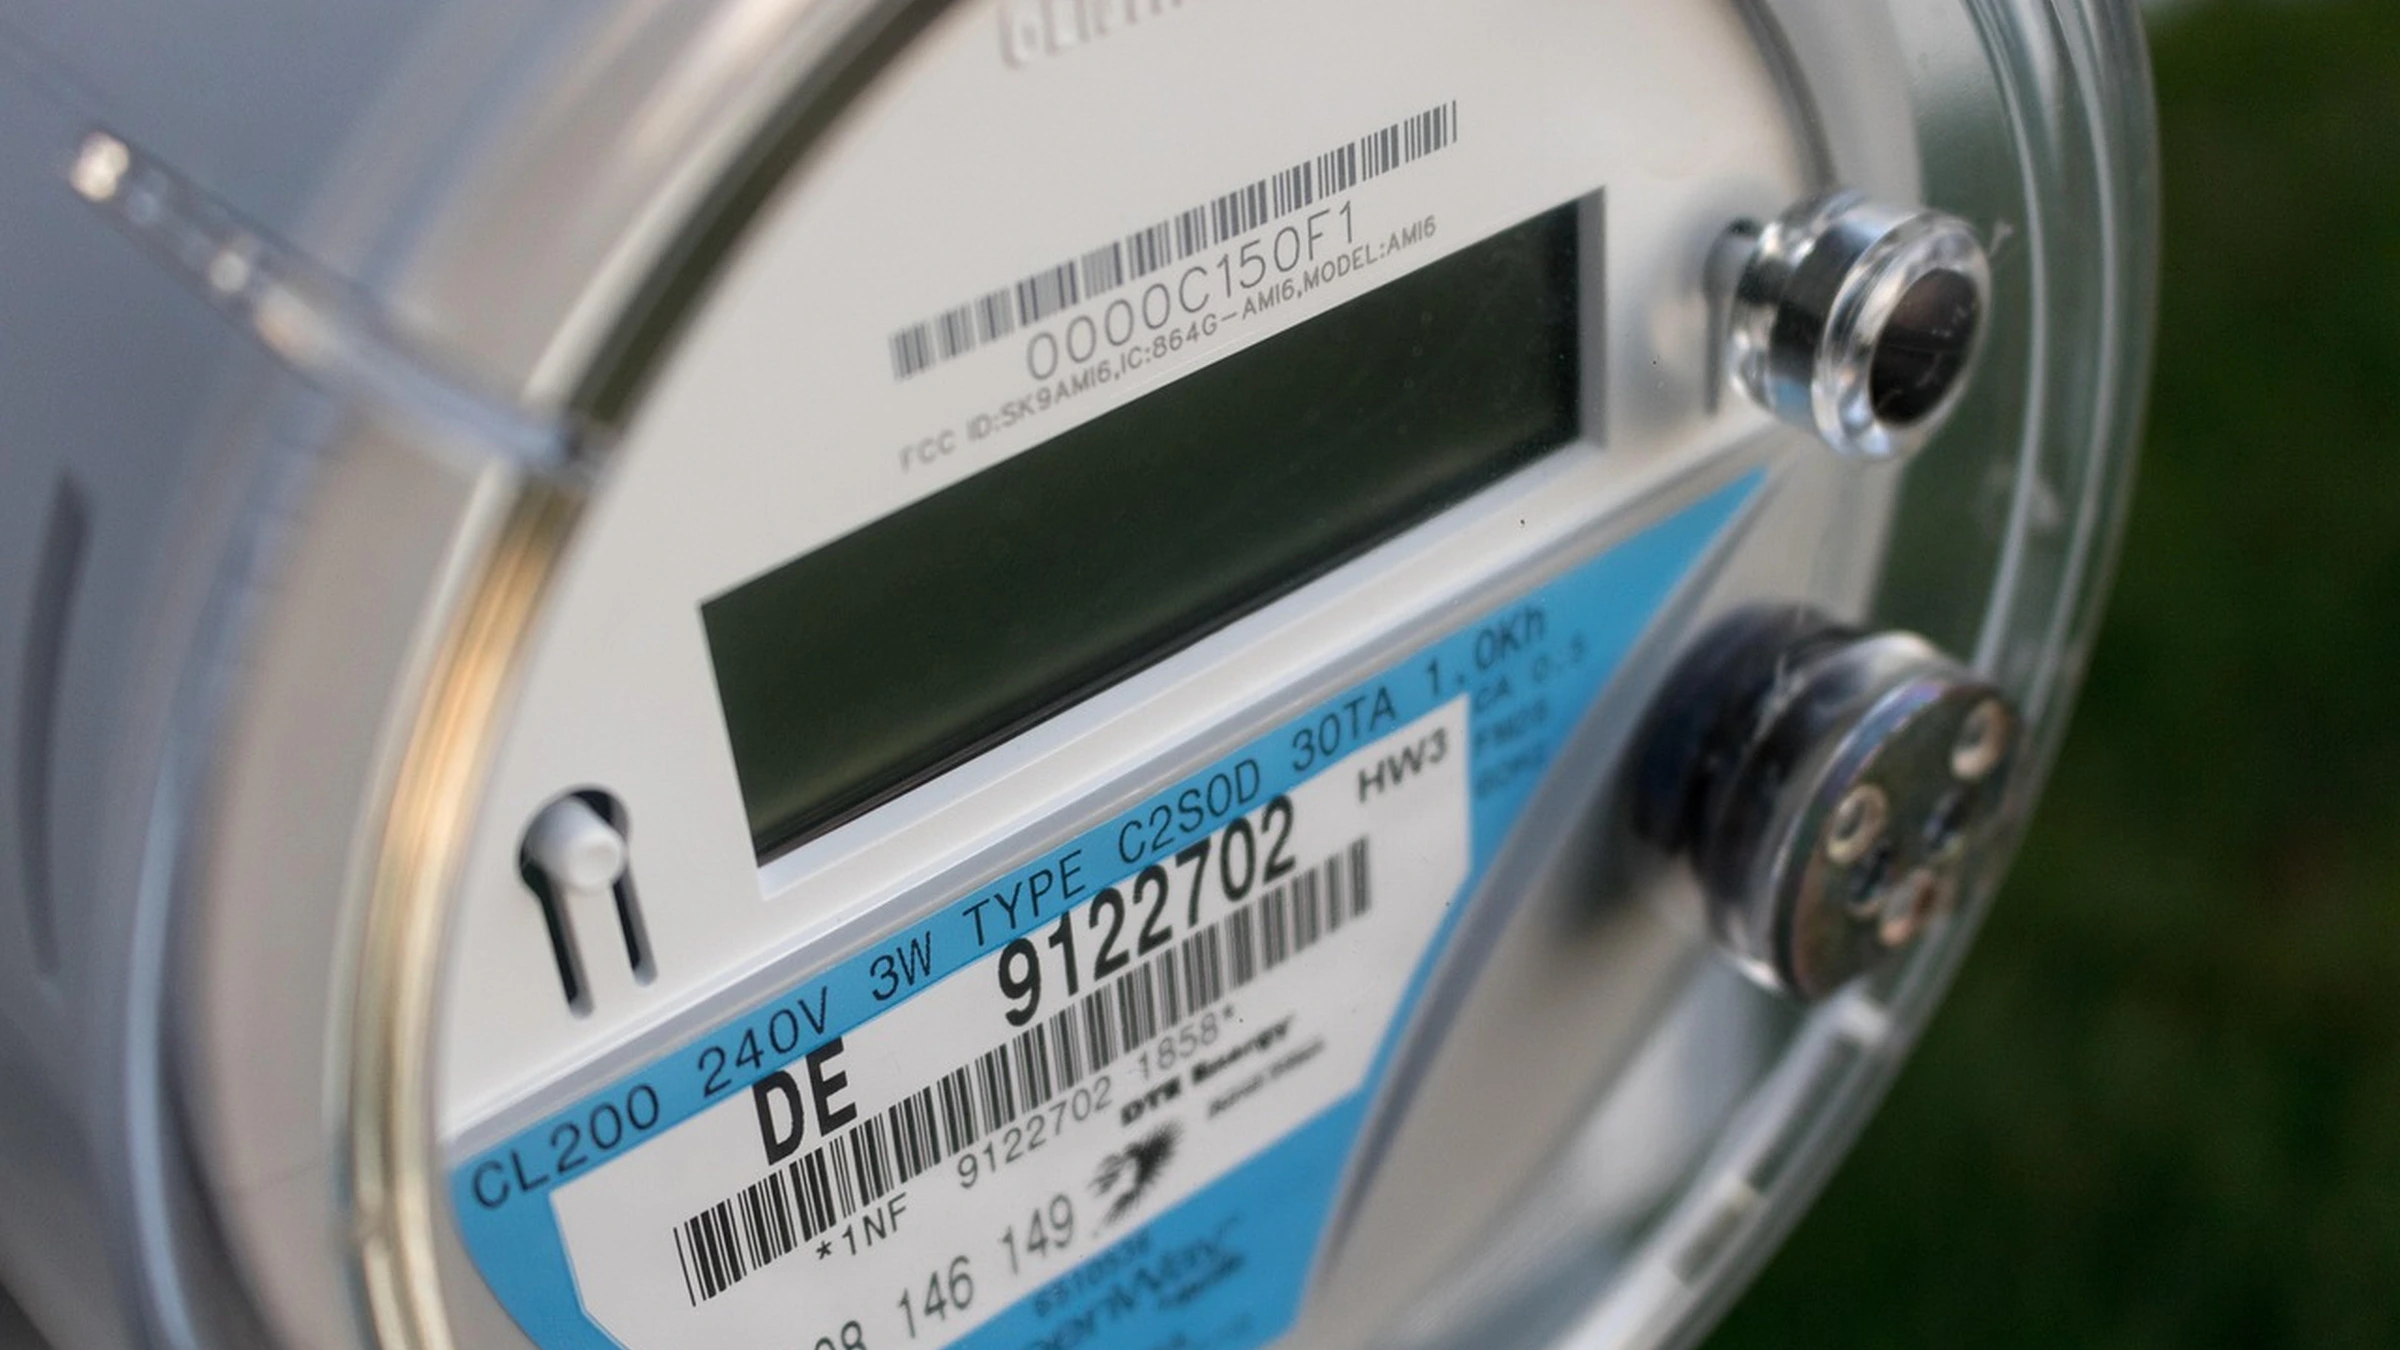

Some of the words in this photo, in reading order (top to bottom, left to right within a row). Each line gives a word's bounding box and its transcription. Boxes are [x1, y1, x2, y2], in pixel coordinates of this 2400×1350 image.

[1026, 200, 1353, 381] 0000C150F1
[900, 428, 957, 473] FCC
[1356, 725, 1449, 805] HW3
[471, 1083, 661, 1211] CL200
[696, 986, 830, 1099] 240V
[869, 931, 933, 1002] 3W
[961, 848, 1087, 948] TYPE
[1291, 685, 1398, 772] 30TA
[999, 794, 1296, 1028] 9122702
[751, 1036, 858, 1167] DE
[956, 1075, 1112, 1189] 9122702
[898, 1255, 975, 1339] 146
[1001, 1193, 1075, 1276] 149
